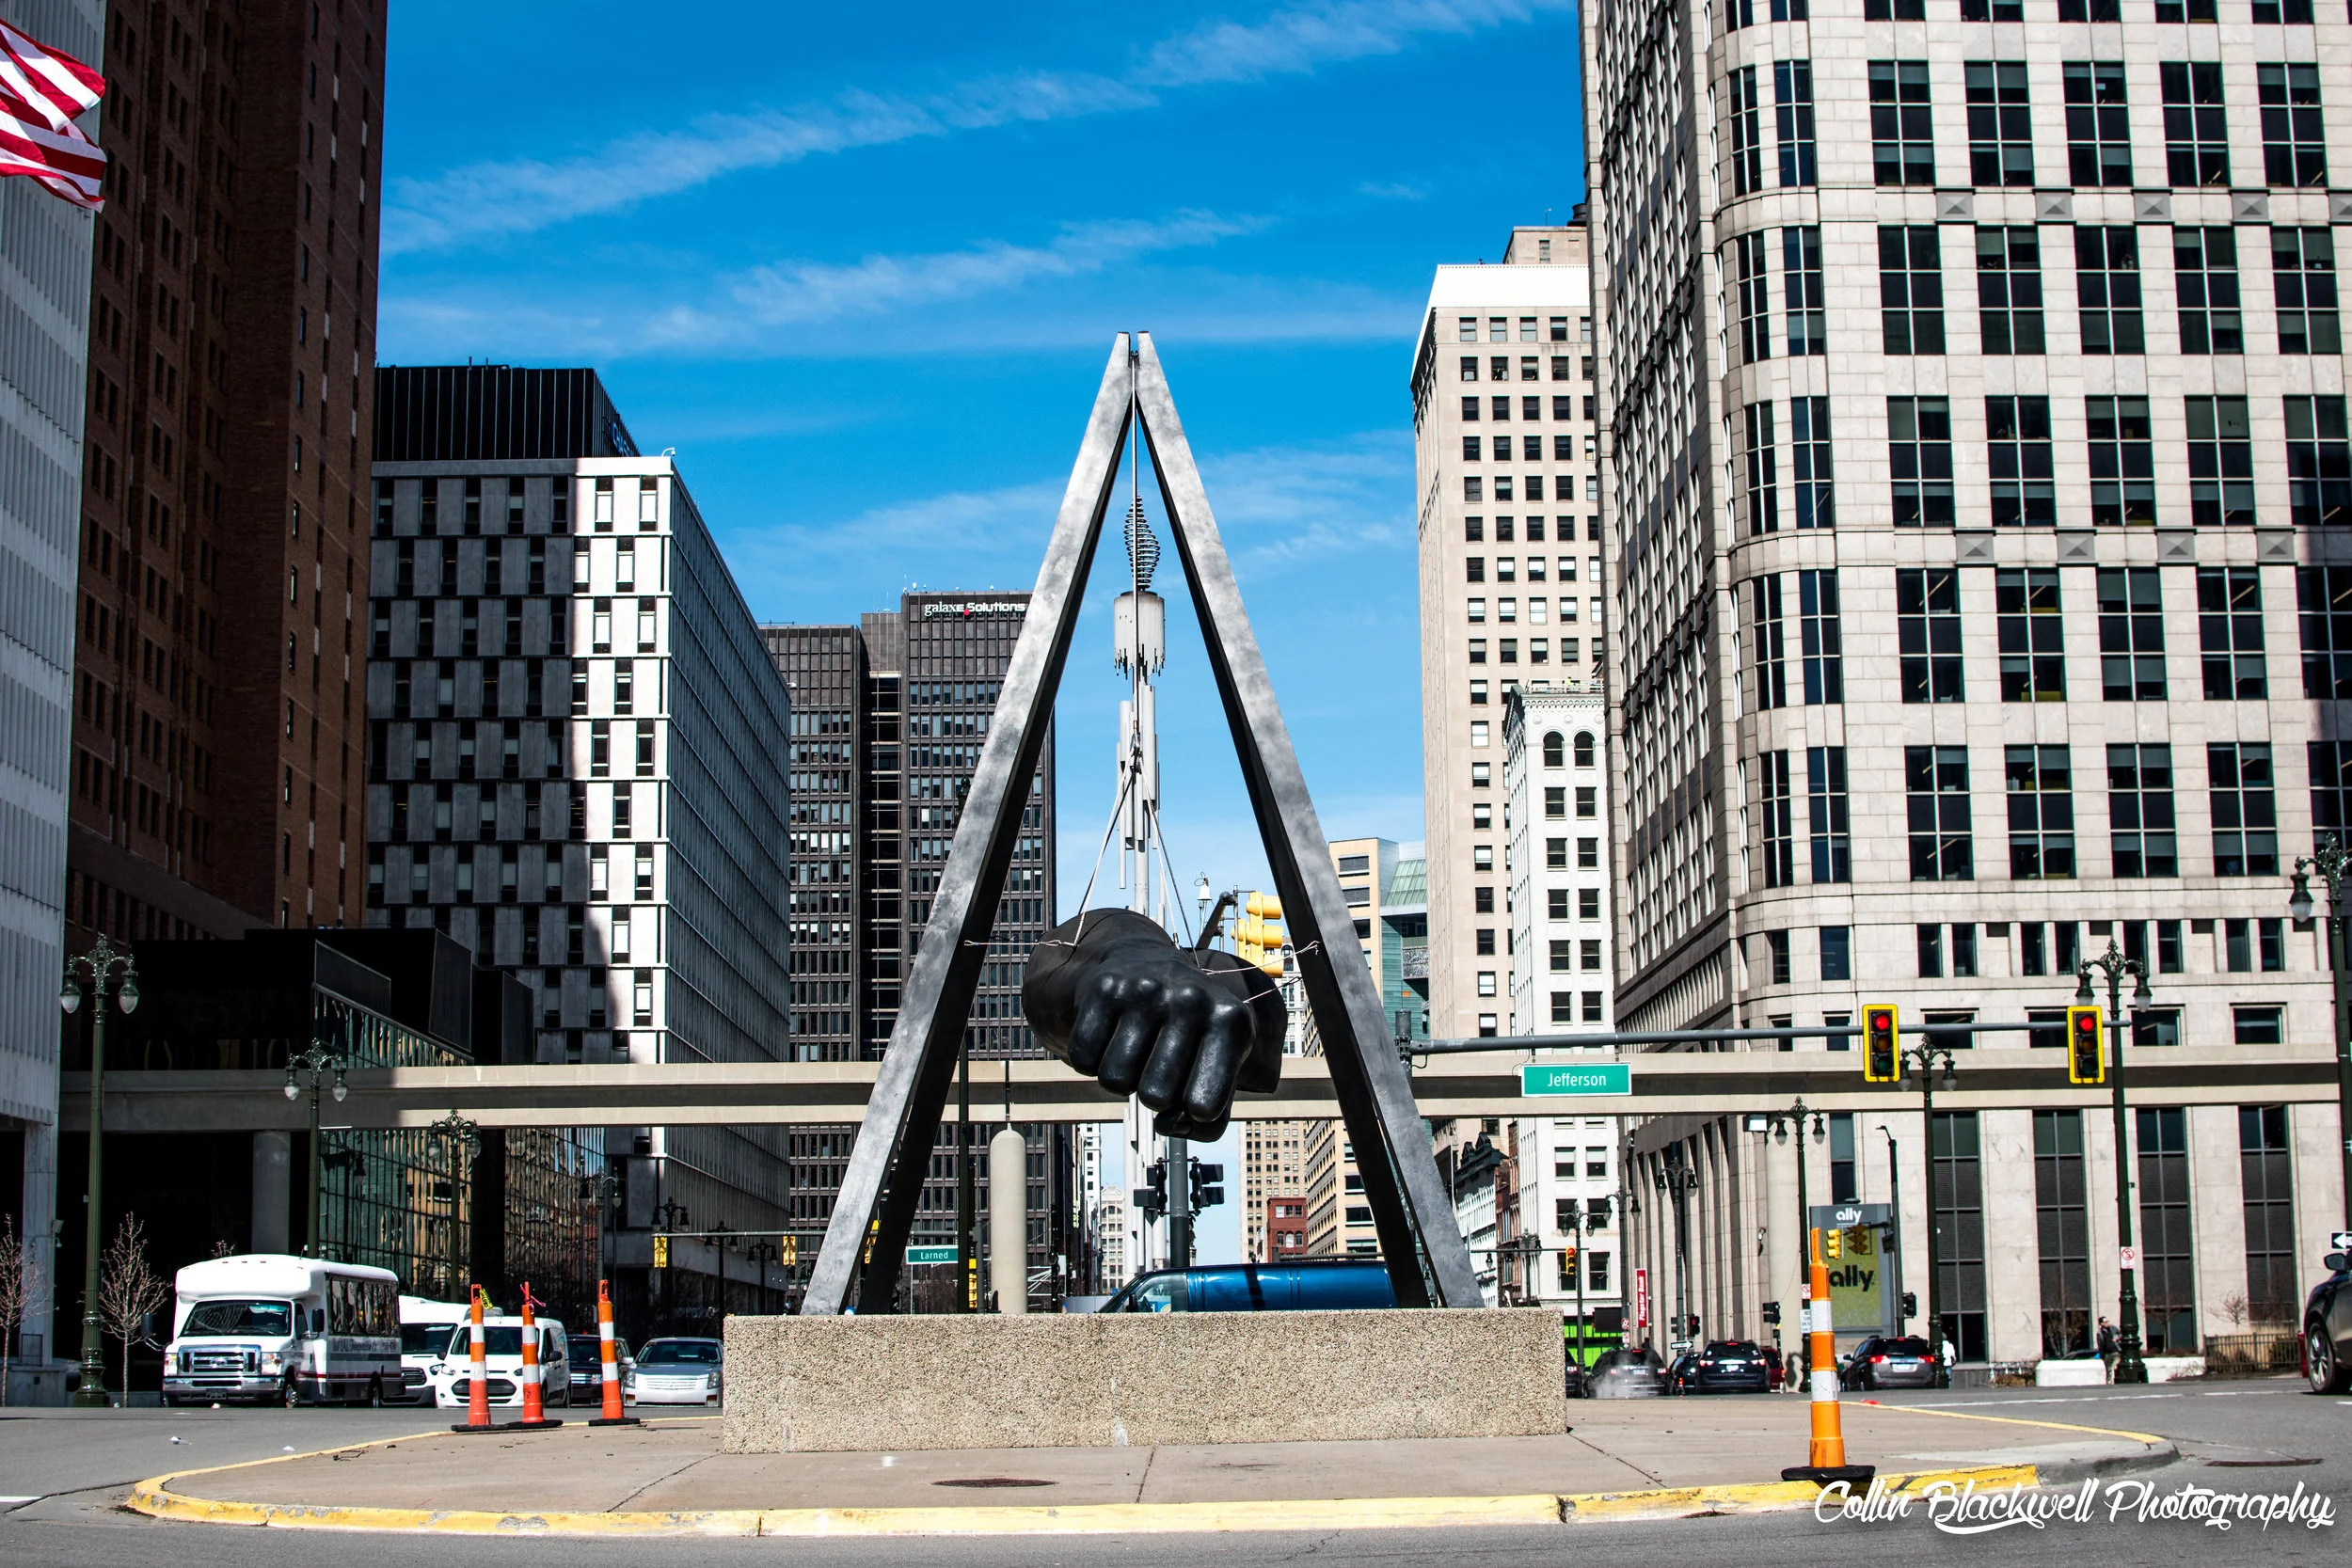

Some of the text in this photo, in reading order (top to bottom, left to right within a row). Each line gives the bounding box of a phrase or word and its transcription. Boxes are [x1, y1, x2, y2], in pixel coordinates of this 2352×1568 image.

[1548, 1072, 1607, 1086] Jefferson
[1836, 1207, 1863, 1225] ally
[920, 1250, 948, 1260] Larned
